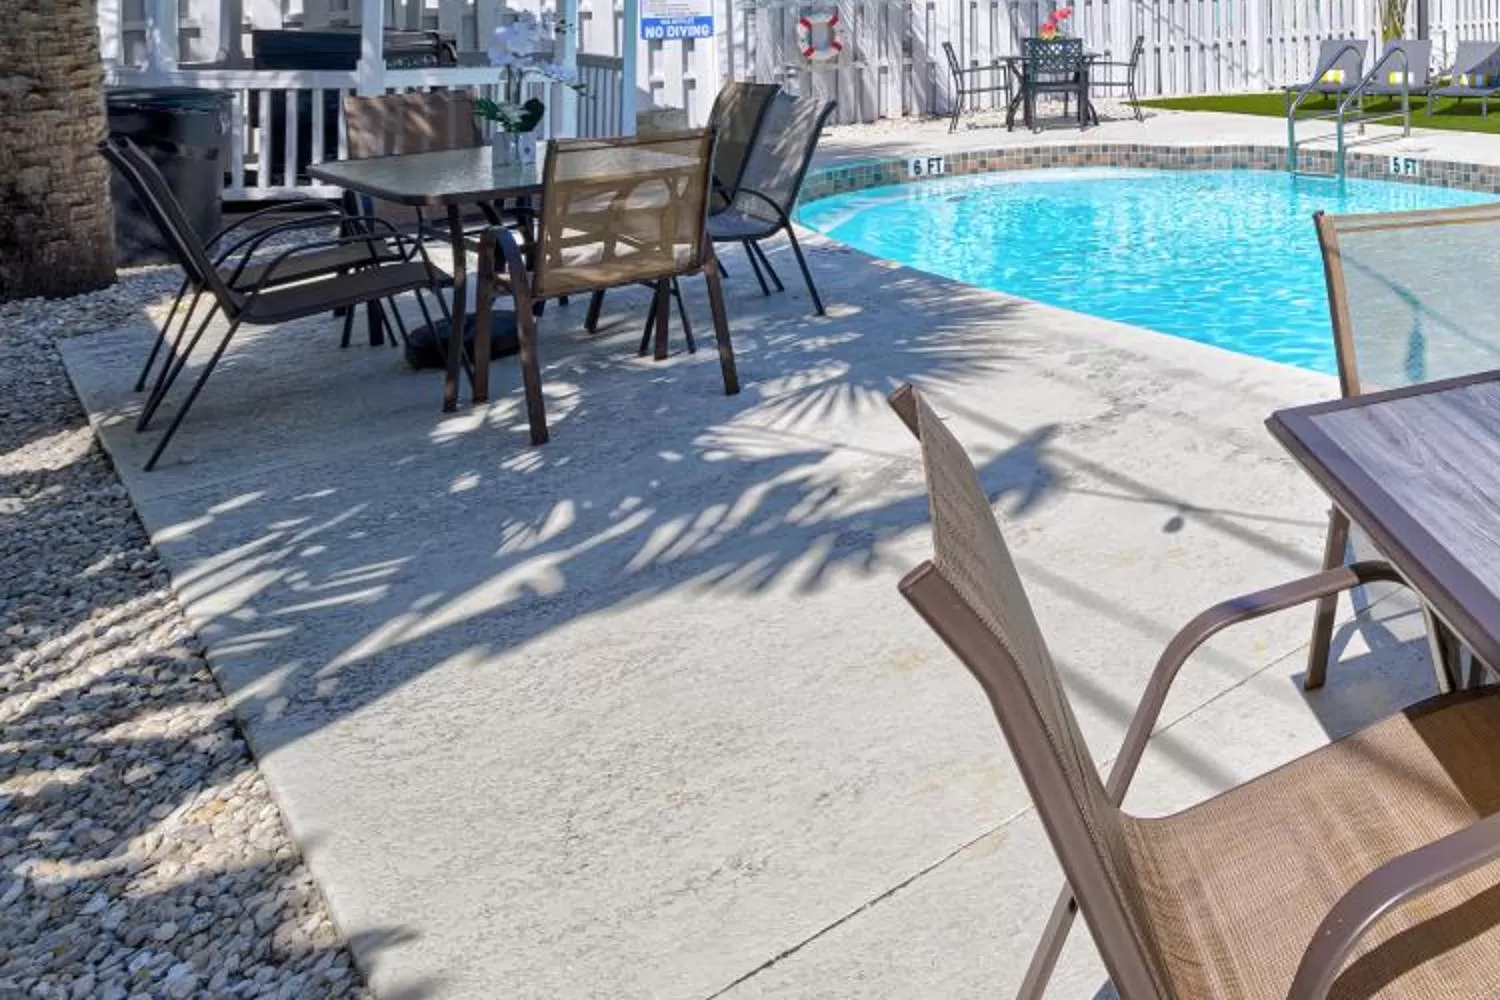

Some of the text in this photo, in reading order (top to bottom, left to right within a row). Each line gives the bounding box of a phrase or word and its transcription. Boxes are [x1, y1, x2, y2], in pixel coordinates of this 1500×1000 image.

[646, 24, 709, 38] NO DIVING
[914, 157, 942, 175] 6 FT
[1393, 157, 1417, 174] 5 FT
